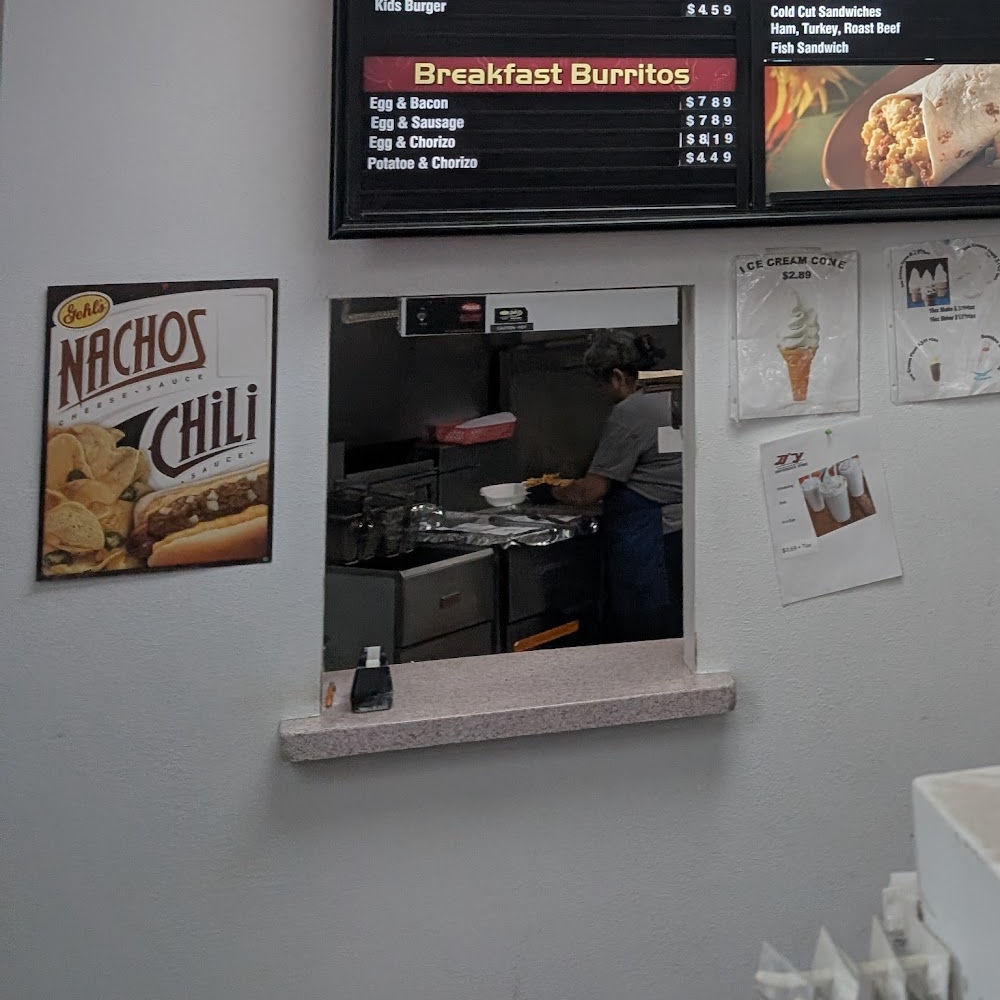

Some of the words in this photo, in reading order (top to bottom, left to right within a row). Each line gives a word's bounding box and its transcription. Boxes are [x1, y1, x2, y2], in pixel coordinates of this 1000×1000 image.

[404, 0, 447, 14] Burger
[770, 5, 795, 18] Cold
[797, 5, 816, 18] Cut
[818, 5, 882, 18] Sandwiches
[770, 22, 800, 36] Ham,
[801, 22, 842, 36] Turkey,
[843, 22, 875, 34] Roast
[876, 22, 901, 34] Beef
[771, 41, 794, 54] Fish
[796, 41, 849, 54] Sandwich
[414, 63, 563, 85] Breakfast
[570, 63, 690, 85] Burritos
[369, 97, 393, 112] Egg
[396, 97, 407, 109] &
[409, 97, 449, 109] Bacon
[370, 116, 395, 131] Egg
[397, 116, 408, 129] &
[411, 116, 465, 131] Sausage
[368, 136, 393, 151] Egg
[395, 136, 406, 148] &
[409, 135, 456, 148] Chorizo
[367, 157, 415, 170] Potatoe
[418, 157, 428, 169] &
[431, 156, 478, 169] Chorizo
[766, 256, 807, 266] CREAM
[811, 256, 847, 270] CONE
[782, 270, 812, 280] $2.89
[57, 309, 207, 411] NACHOS
[146, 374, 204, 391] SAUCE
[190, 453, 244, 480] SAUCE
